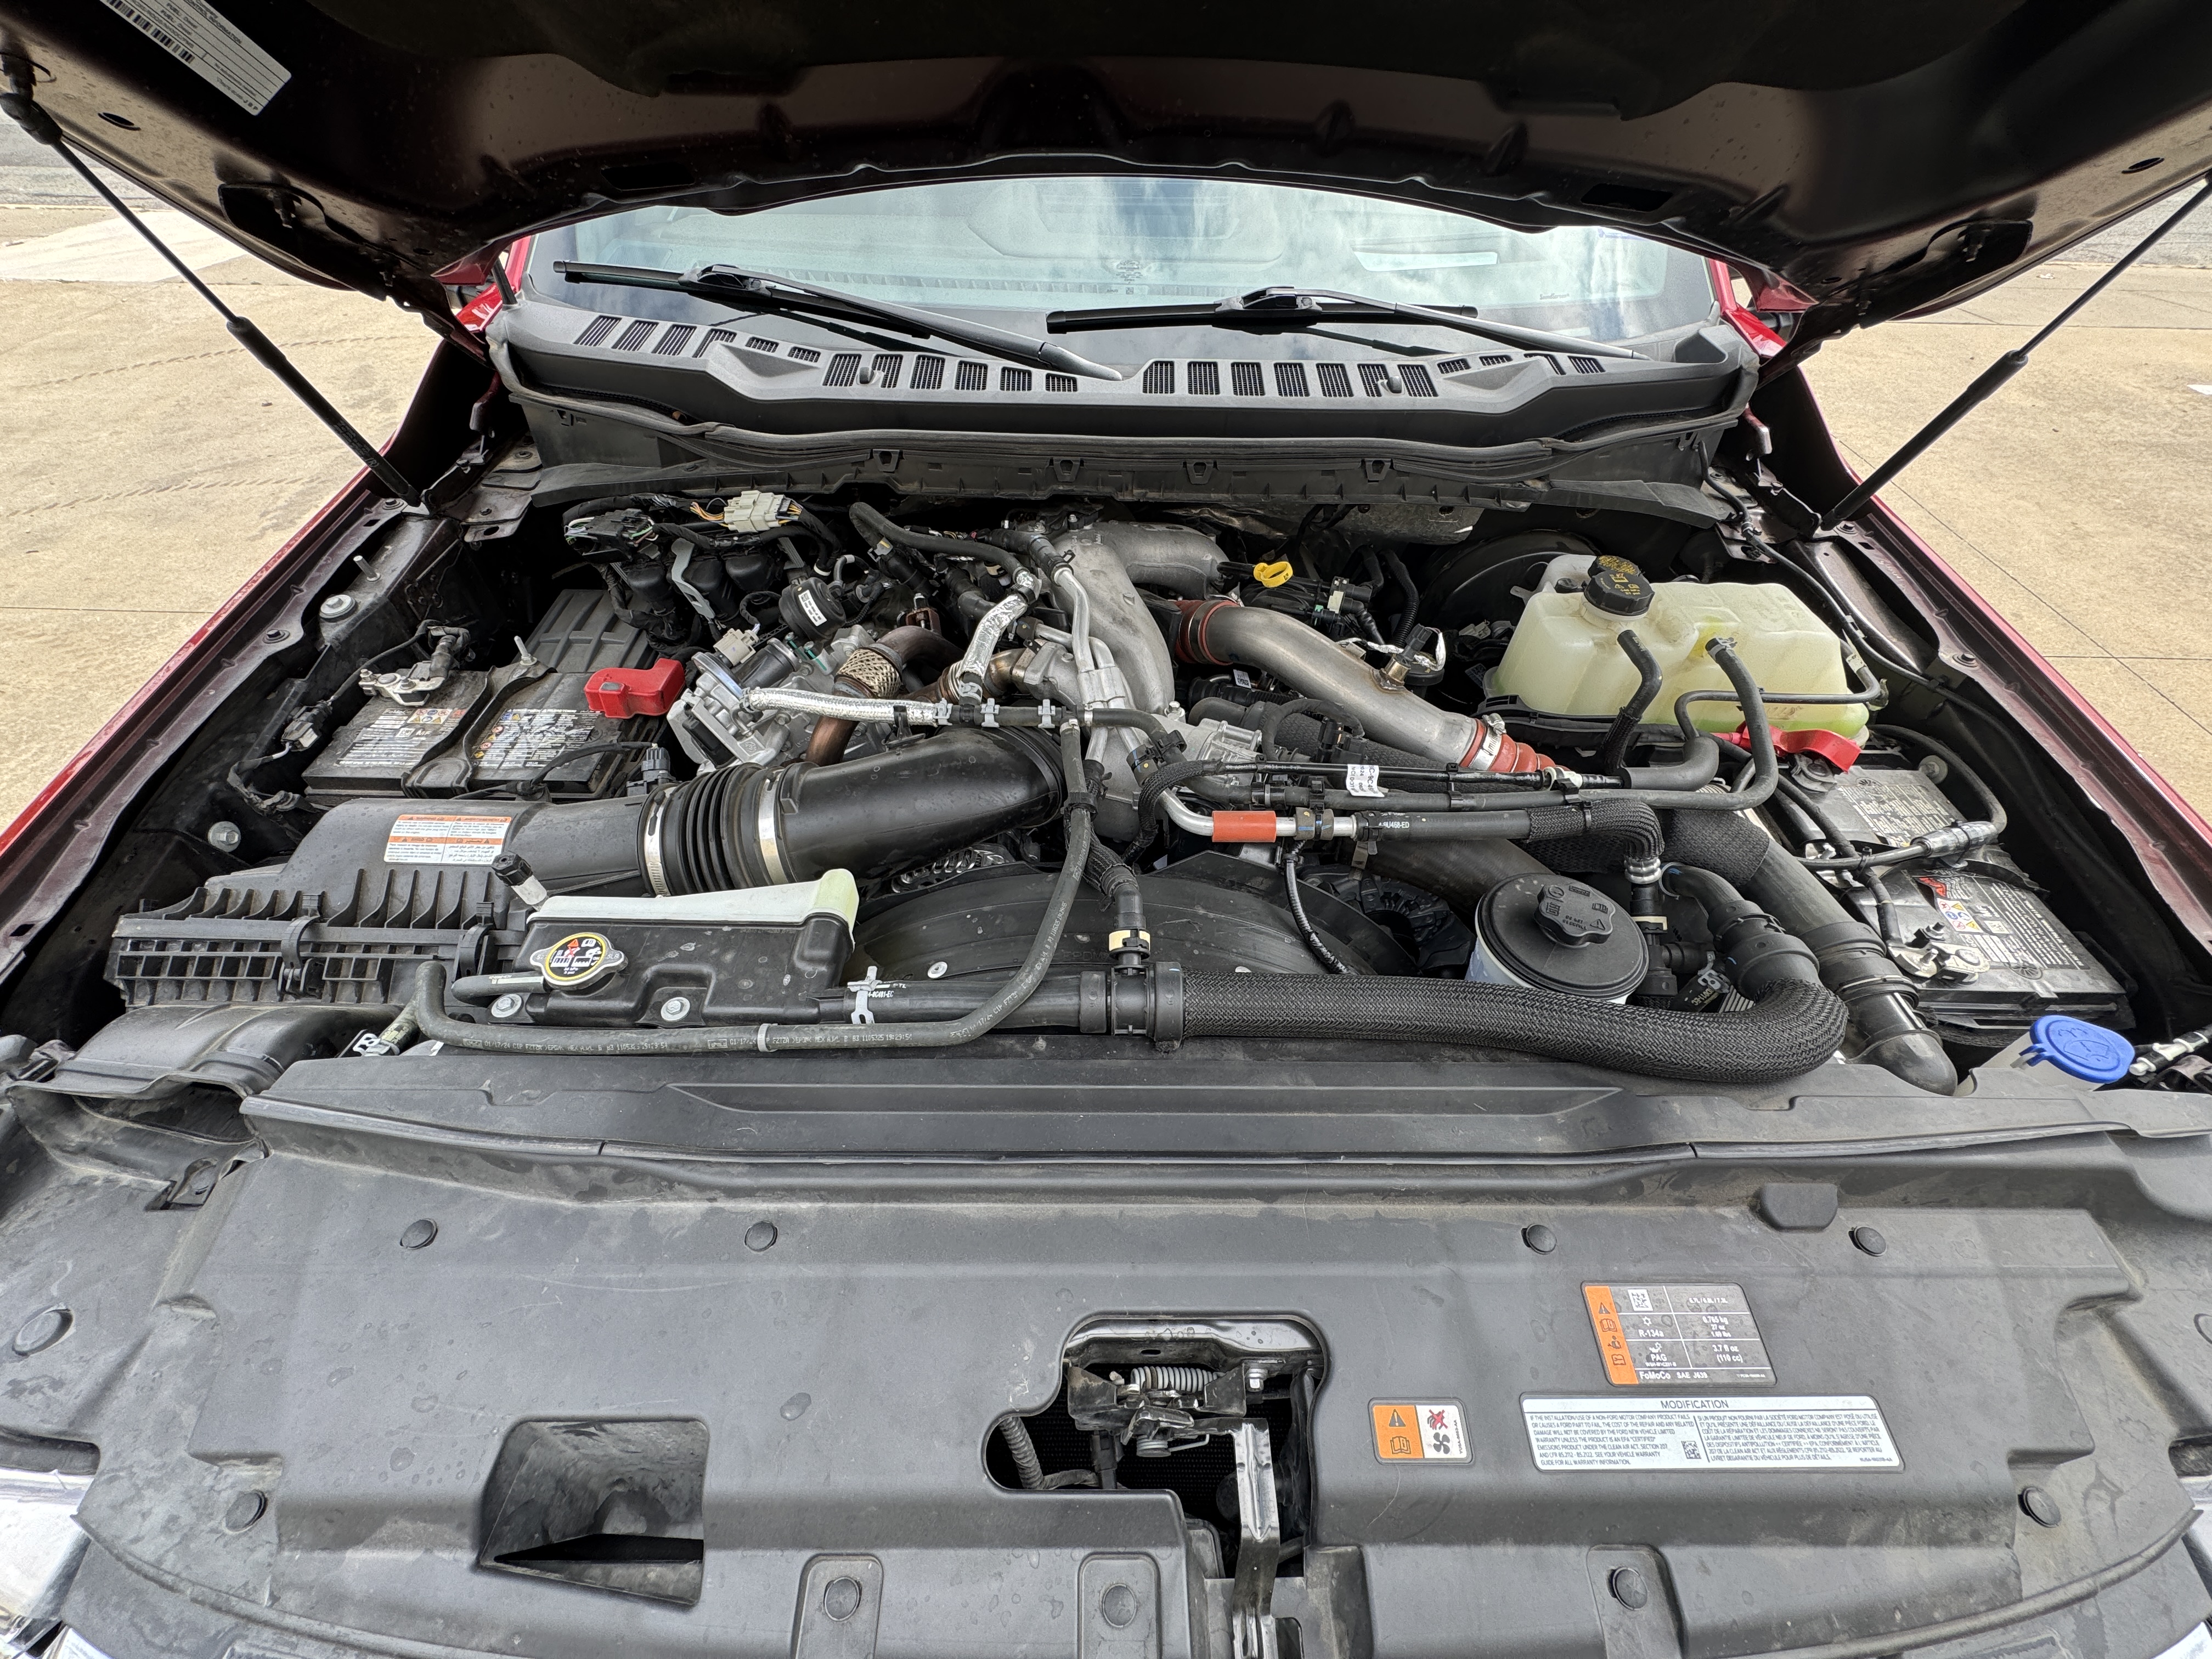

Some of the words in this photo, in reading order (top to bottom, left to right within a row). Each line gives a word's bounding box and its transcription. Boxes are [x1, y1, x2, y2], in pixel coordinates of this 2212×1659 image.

[1719, 1316, 1729, 1324] kg
[1638, 1329, 1664, 1338] R-134a
[1712, 1344, 1722, 1352] 3.7
[1650, 1353, 1668, 1362] PAG
[1639, 1371, 1671, 1380] FoMoCo
[1660, 1400, 1729, 1409] MODIFICATION
